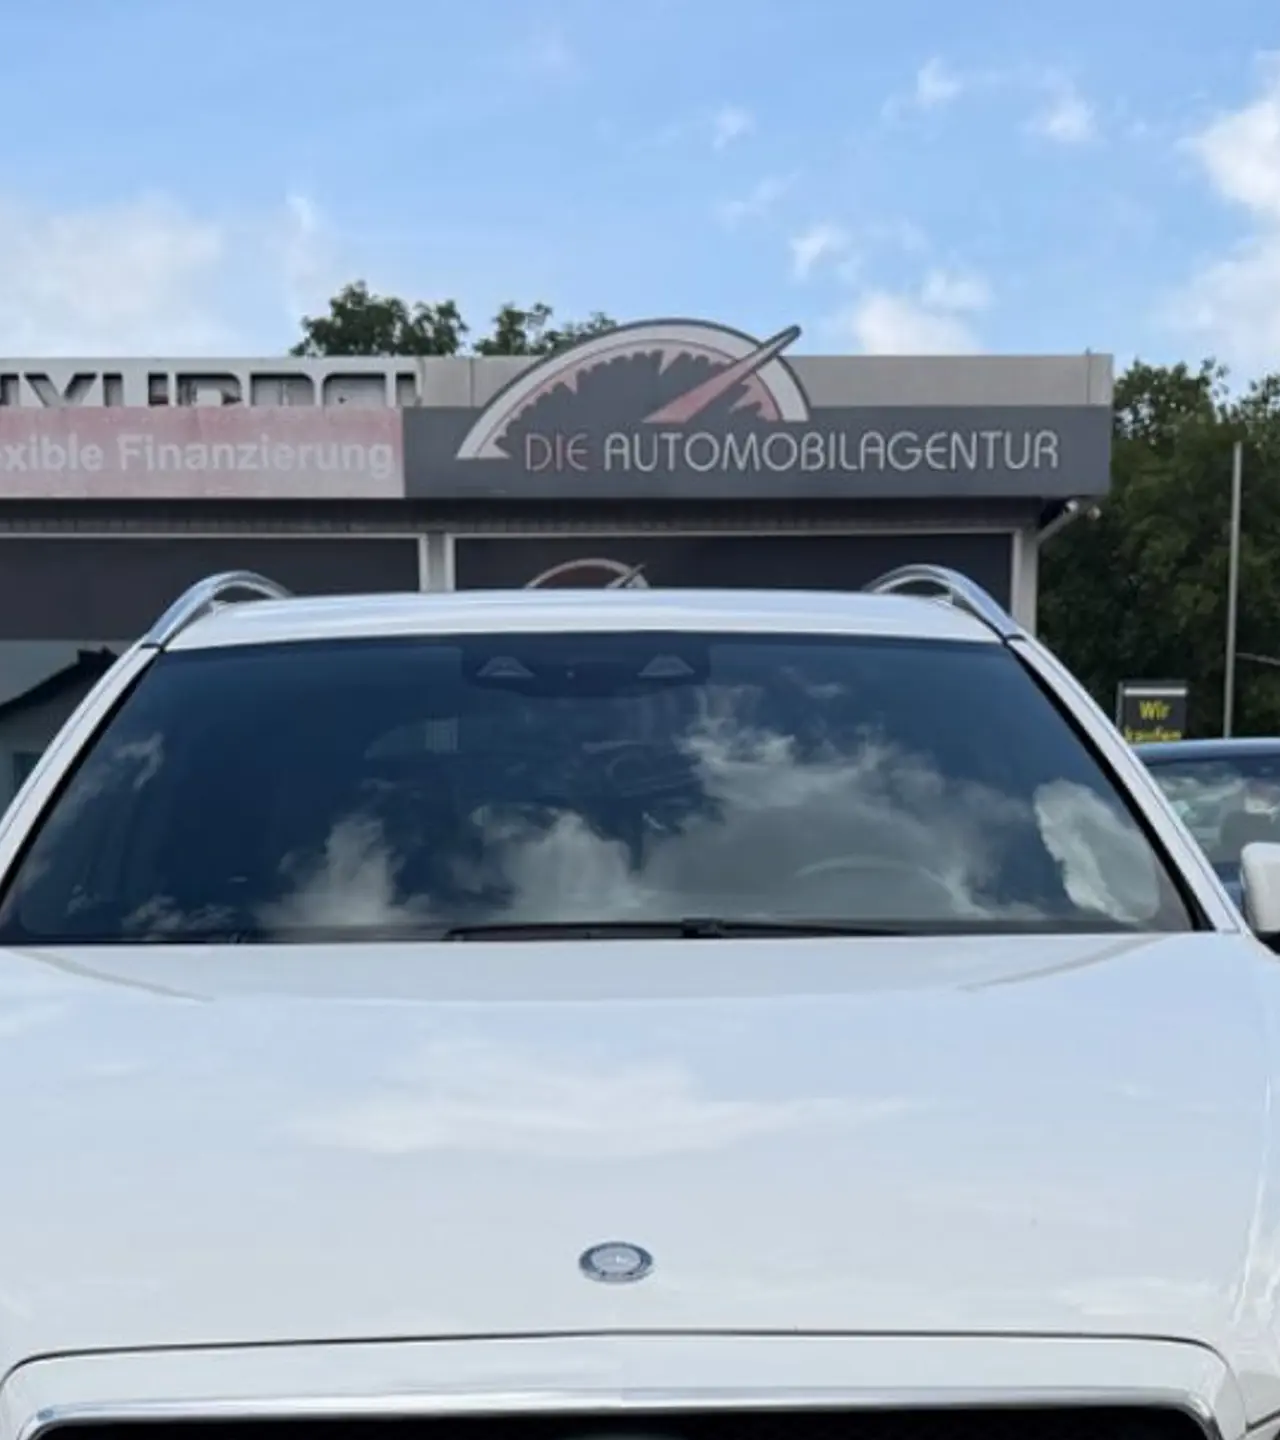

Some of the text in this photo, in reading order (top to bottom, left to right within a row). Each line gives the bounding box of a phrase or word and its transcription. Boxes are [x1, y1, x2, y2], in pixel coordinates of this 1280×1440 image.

[120, 434, 394, 478] Finanzierung
[525, 431, 1058, 472] DIE AUTOMOBILAGENTUR
[1140, 700, 1171, 720] Wir
